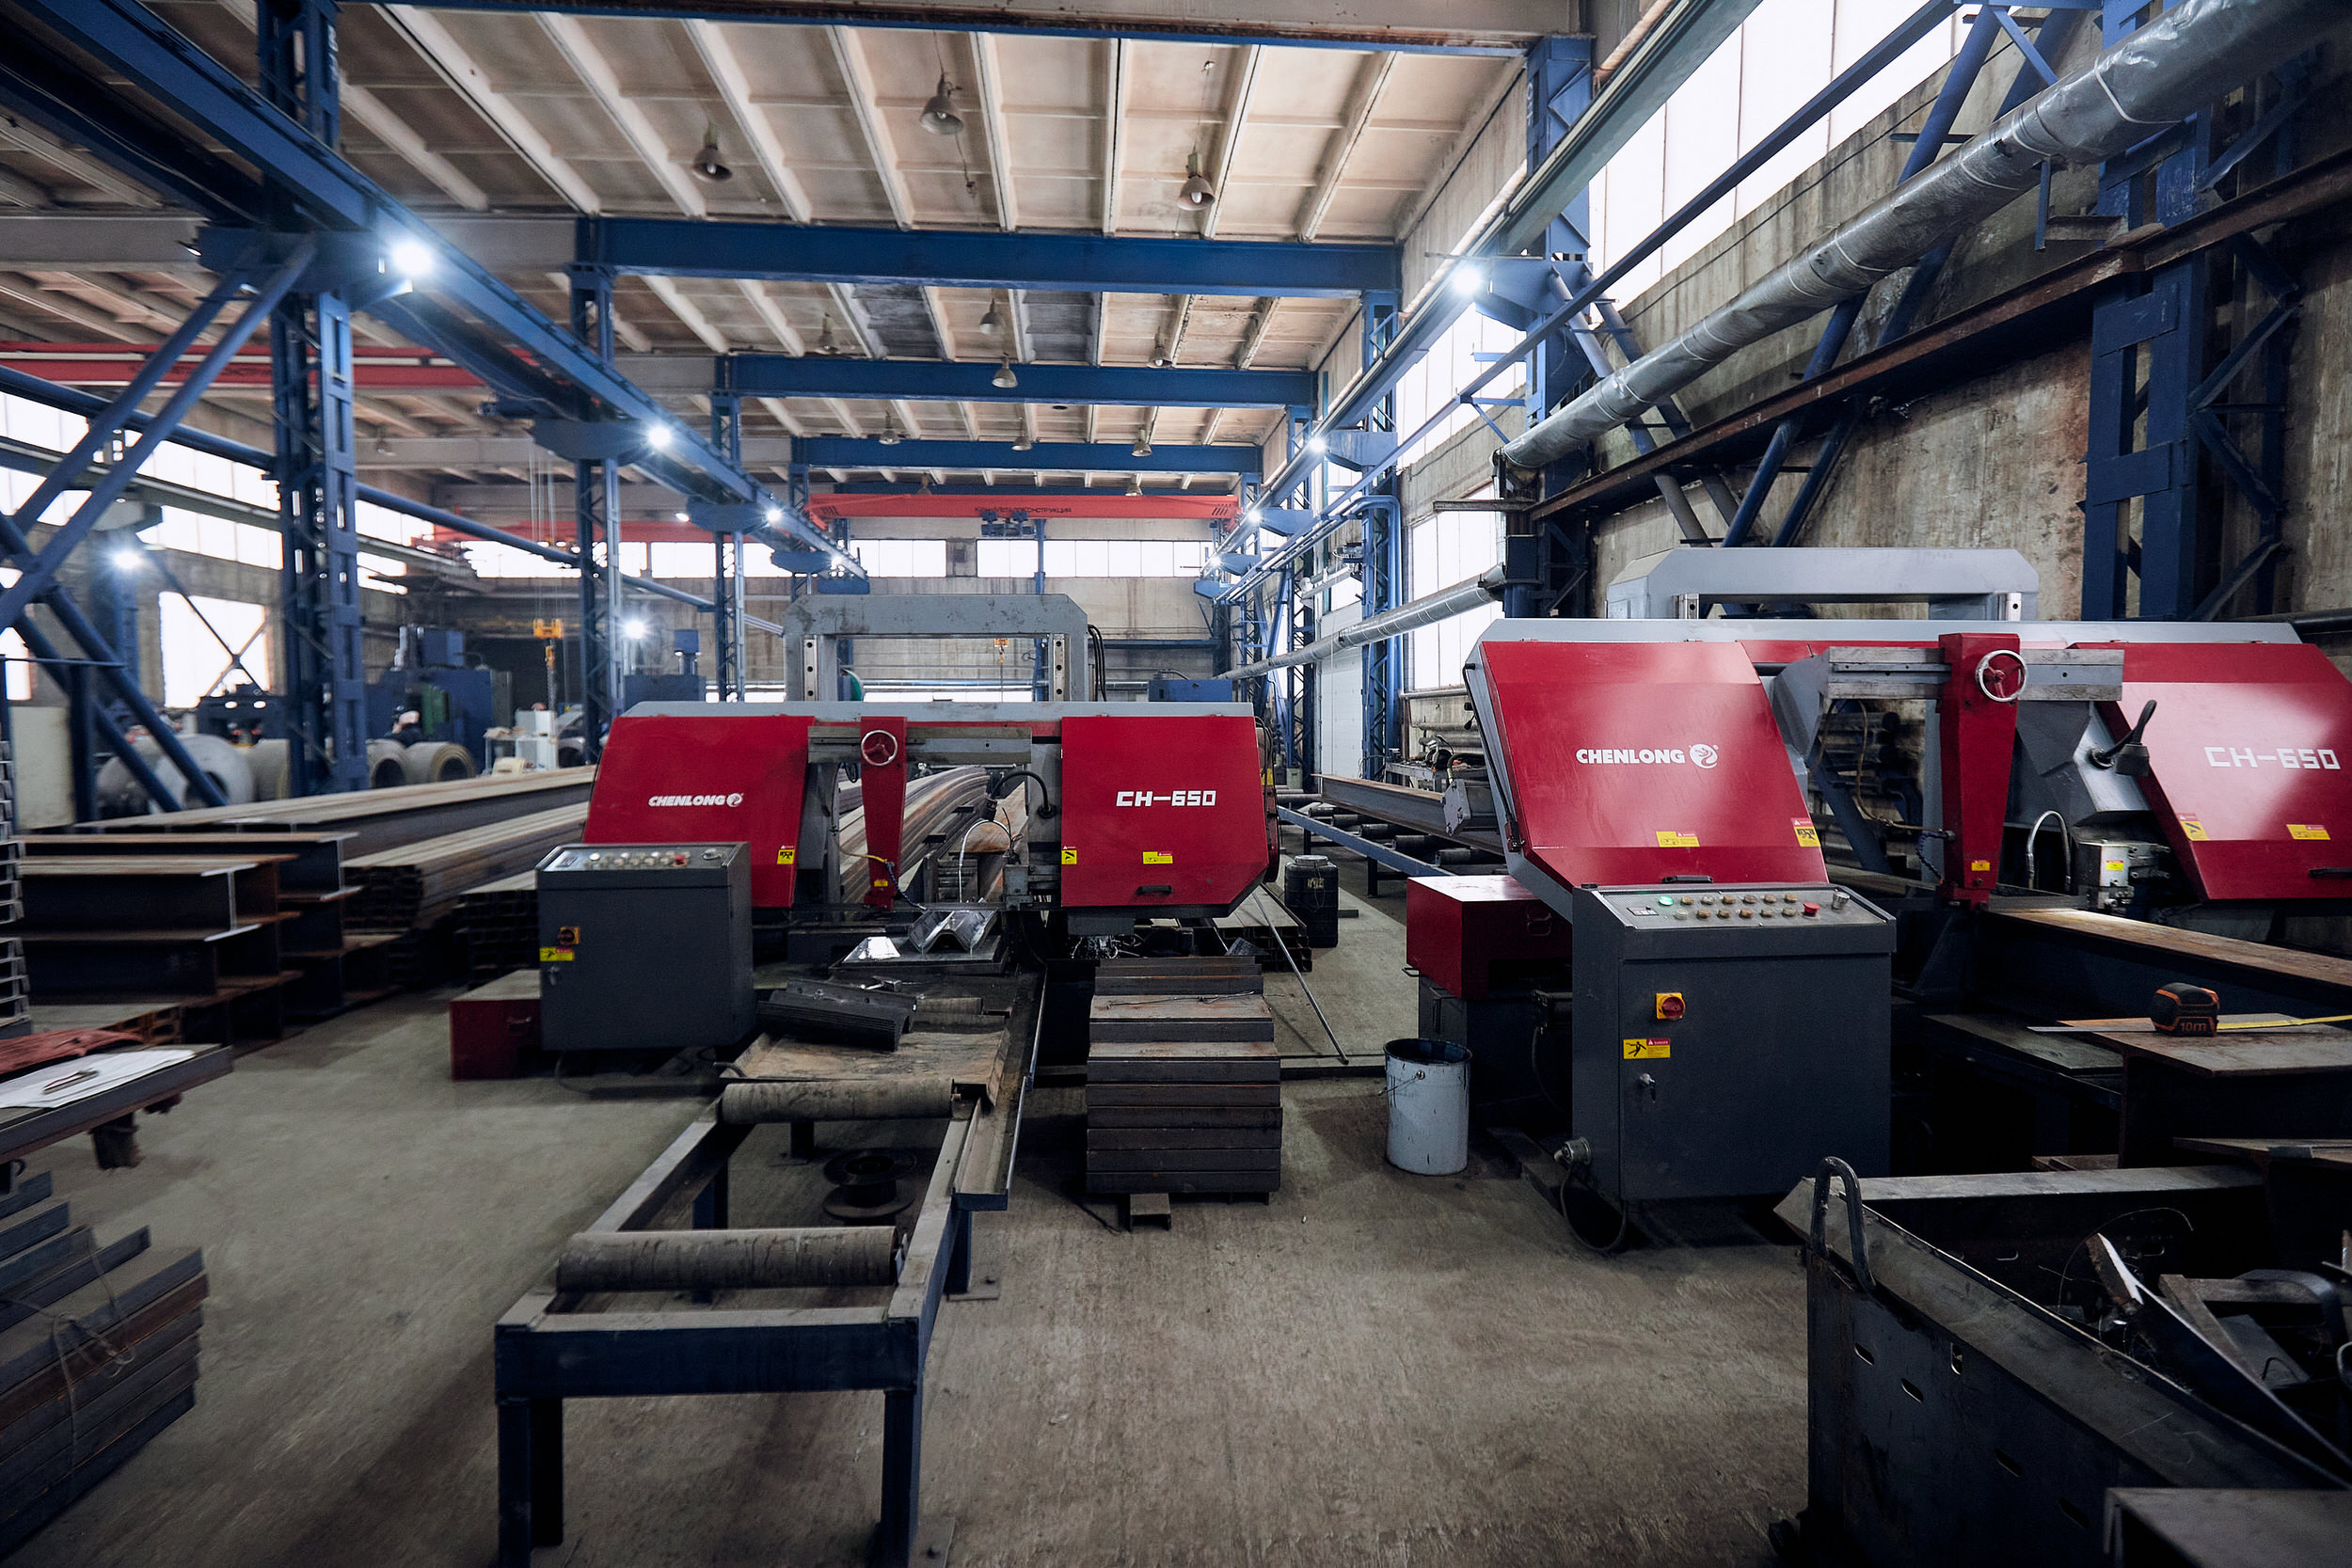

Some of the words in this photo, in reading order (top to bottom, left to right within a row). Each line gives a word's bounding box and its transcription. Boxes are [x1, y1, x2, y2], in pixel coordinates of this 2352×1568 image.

[1575, 749, 1686, 764] CHENLONG
[2203, 746, 2341, 769] CH-650
[648, 795, 726, 807] CHENLONG
[1116, 790, 1216, 807] CH-650
[2180, 1022, 2207, 1032] 10m
